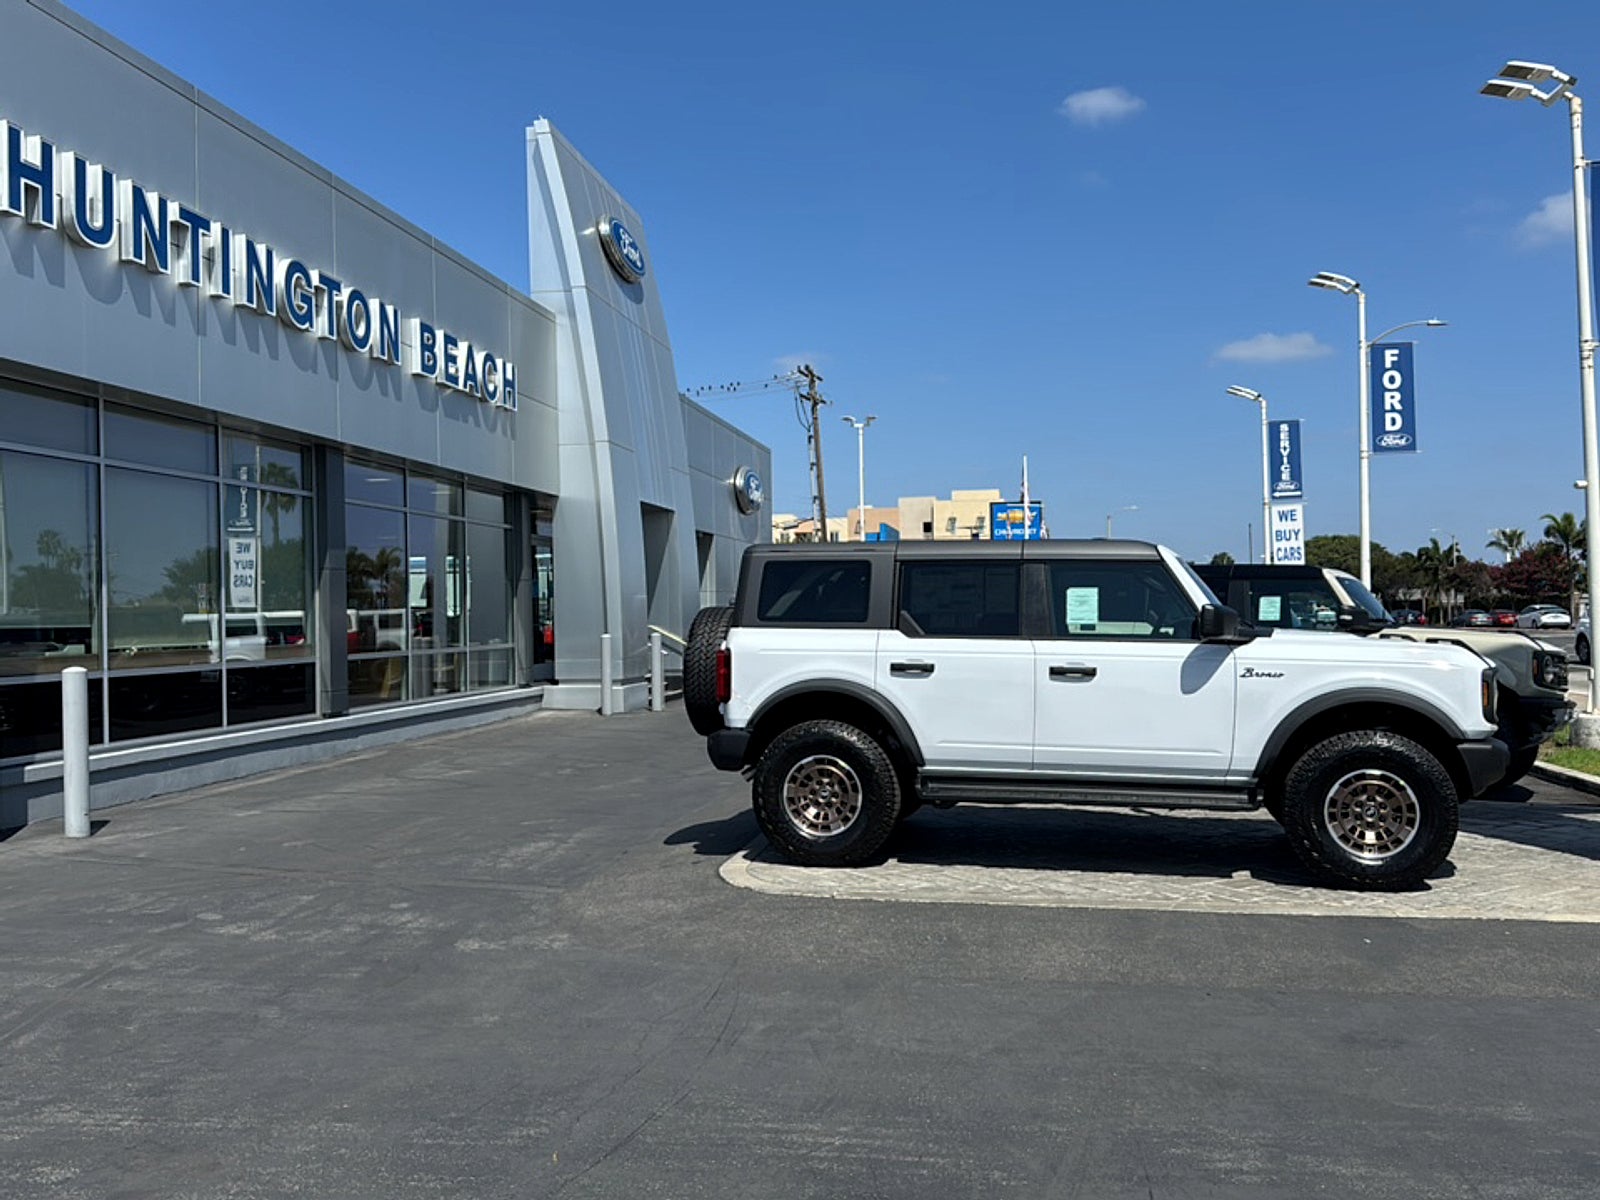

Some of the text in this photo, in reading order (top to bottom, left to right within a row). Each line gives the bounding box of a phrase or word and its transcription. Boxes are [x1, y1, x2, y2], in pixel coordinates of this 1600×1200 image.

[1, 119, 518, 411] HUNTINGTON BEACH
[1382, 348, 1404, 432] FORD
[1380, 434, 1407, 447] Ford
[1279, 423, 1291, 481] SERVICE
[1277, 509, 1298, 522] WE
[1275, 529, 1301, 542] BUY
[1276, 546, 1303, 562] CARS
[1239, 667, 1285, 678] Bronco
